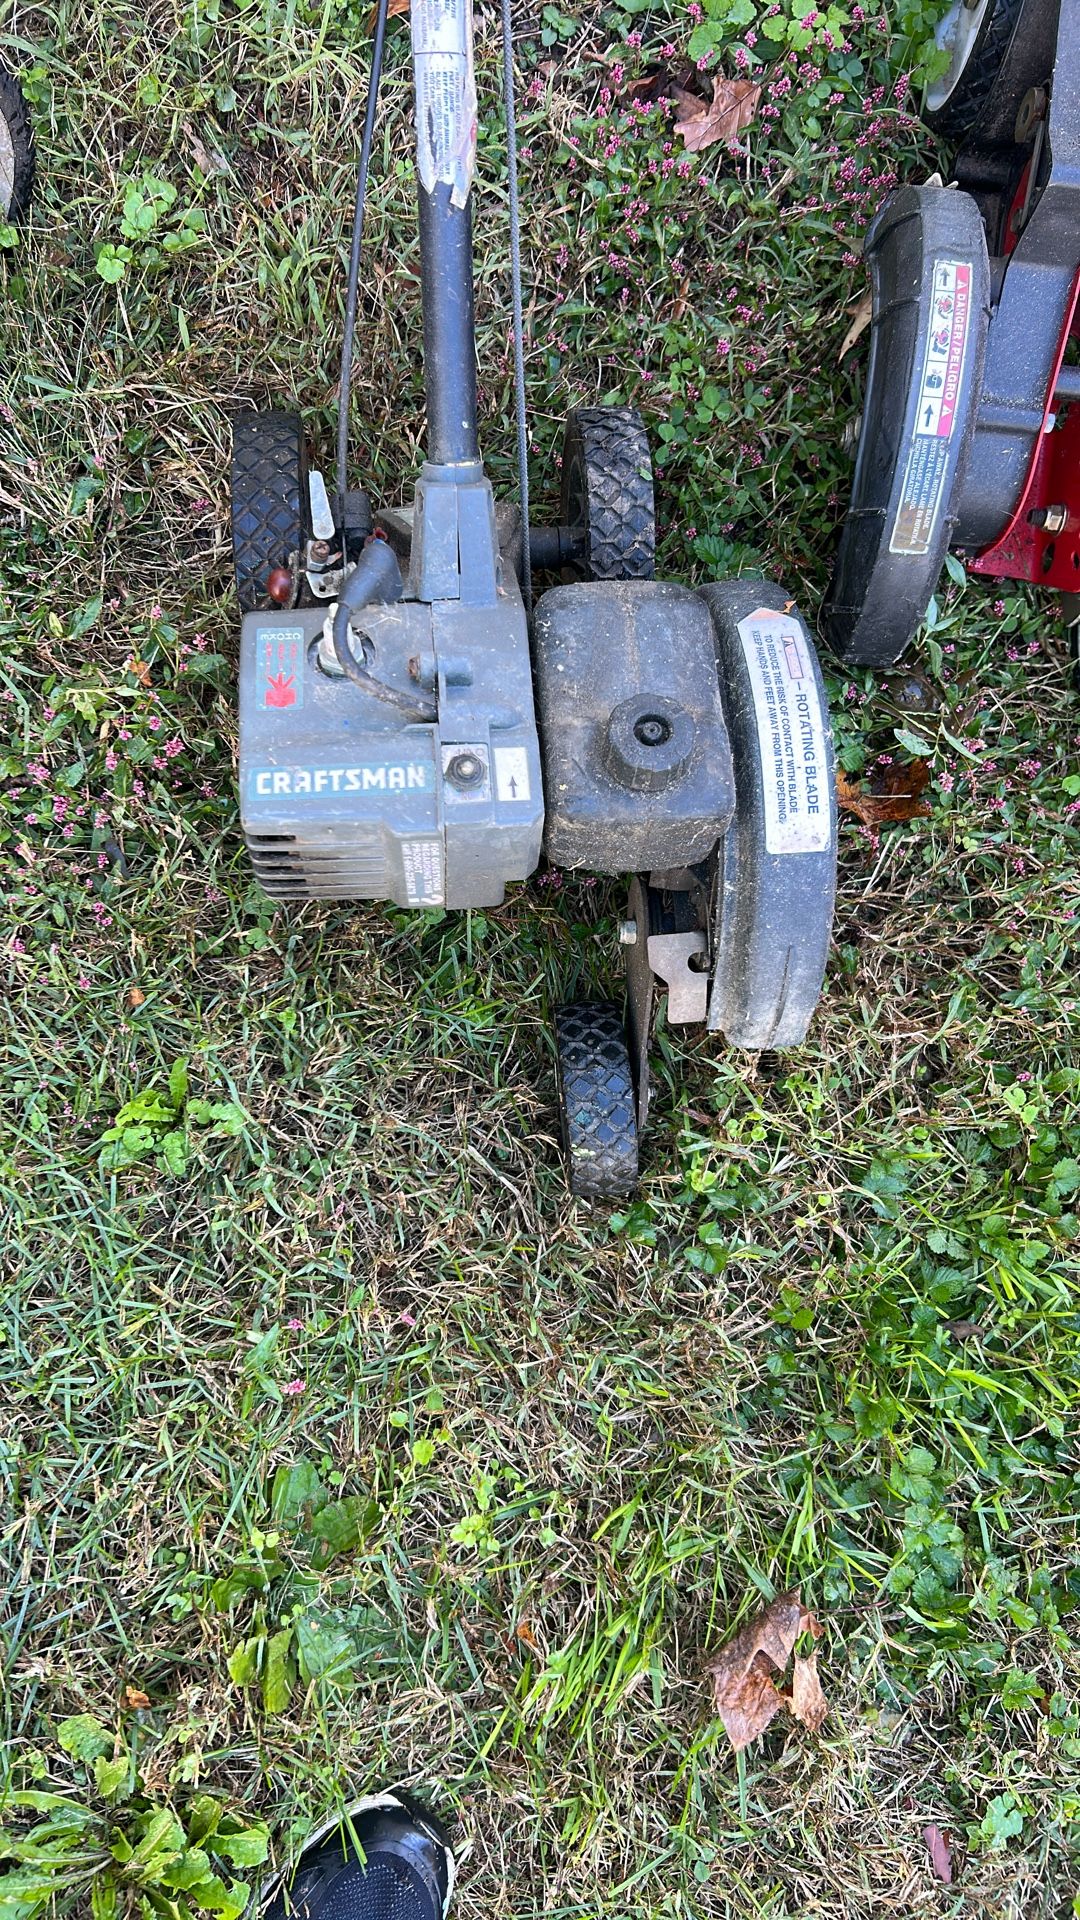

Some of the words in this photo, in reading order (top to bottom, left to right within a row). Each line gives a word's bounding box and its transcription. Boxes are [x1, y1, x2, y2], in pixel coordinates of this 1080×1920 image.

[911, 438, 923, 469] CUCHILLA
[928, 440, 938, 462] RESTEZ
[927, 480, 939, 508] ROTATING
[917, 510, 924, 518] EN
[260, 632, 301, 640] CHOKE
[752, 630, 763, 646] KEEP
[764, 634, 773, 643] TO
[756, 647, 768, 670] HANDS
[768, 644, 780, 671] REDUCE
[762, 671, 772, 686] AND
[773, 671, 783, 685] THE
[765, 686, 776, 706] FEET
[776, 686, 786, 704] RISK
[768, 707, 780, 730] AWAY
[780, 706, 789, 717] OF
[782, 718, 794, 758] CONTACT
[796, 694, 815, 762] ROTATING
[772, 732, 782, 756] FROM
[774, 758, 784, 778] THIS
[786, 760, 796, 782] WITH
[256, 766, 426, 795] CRAFTSMAN
[805, 766, 819, 814] BLADE
[788, 784, 798, 814] BLADE
[411, 844, 423, 874] PRODUCT
[430, 844, 440, 856] FOR
[430, 857, 442, 891] QUESTIONS
